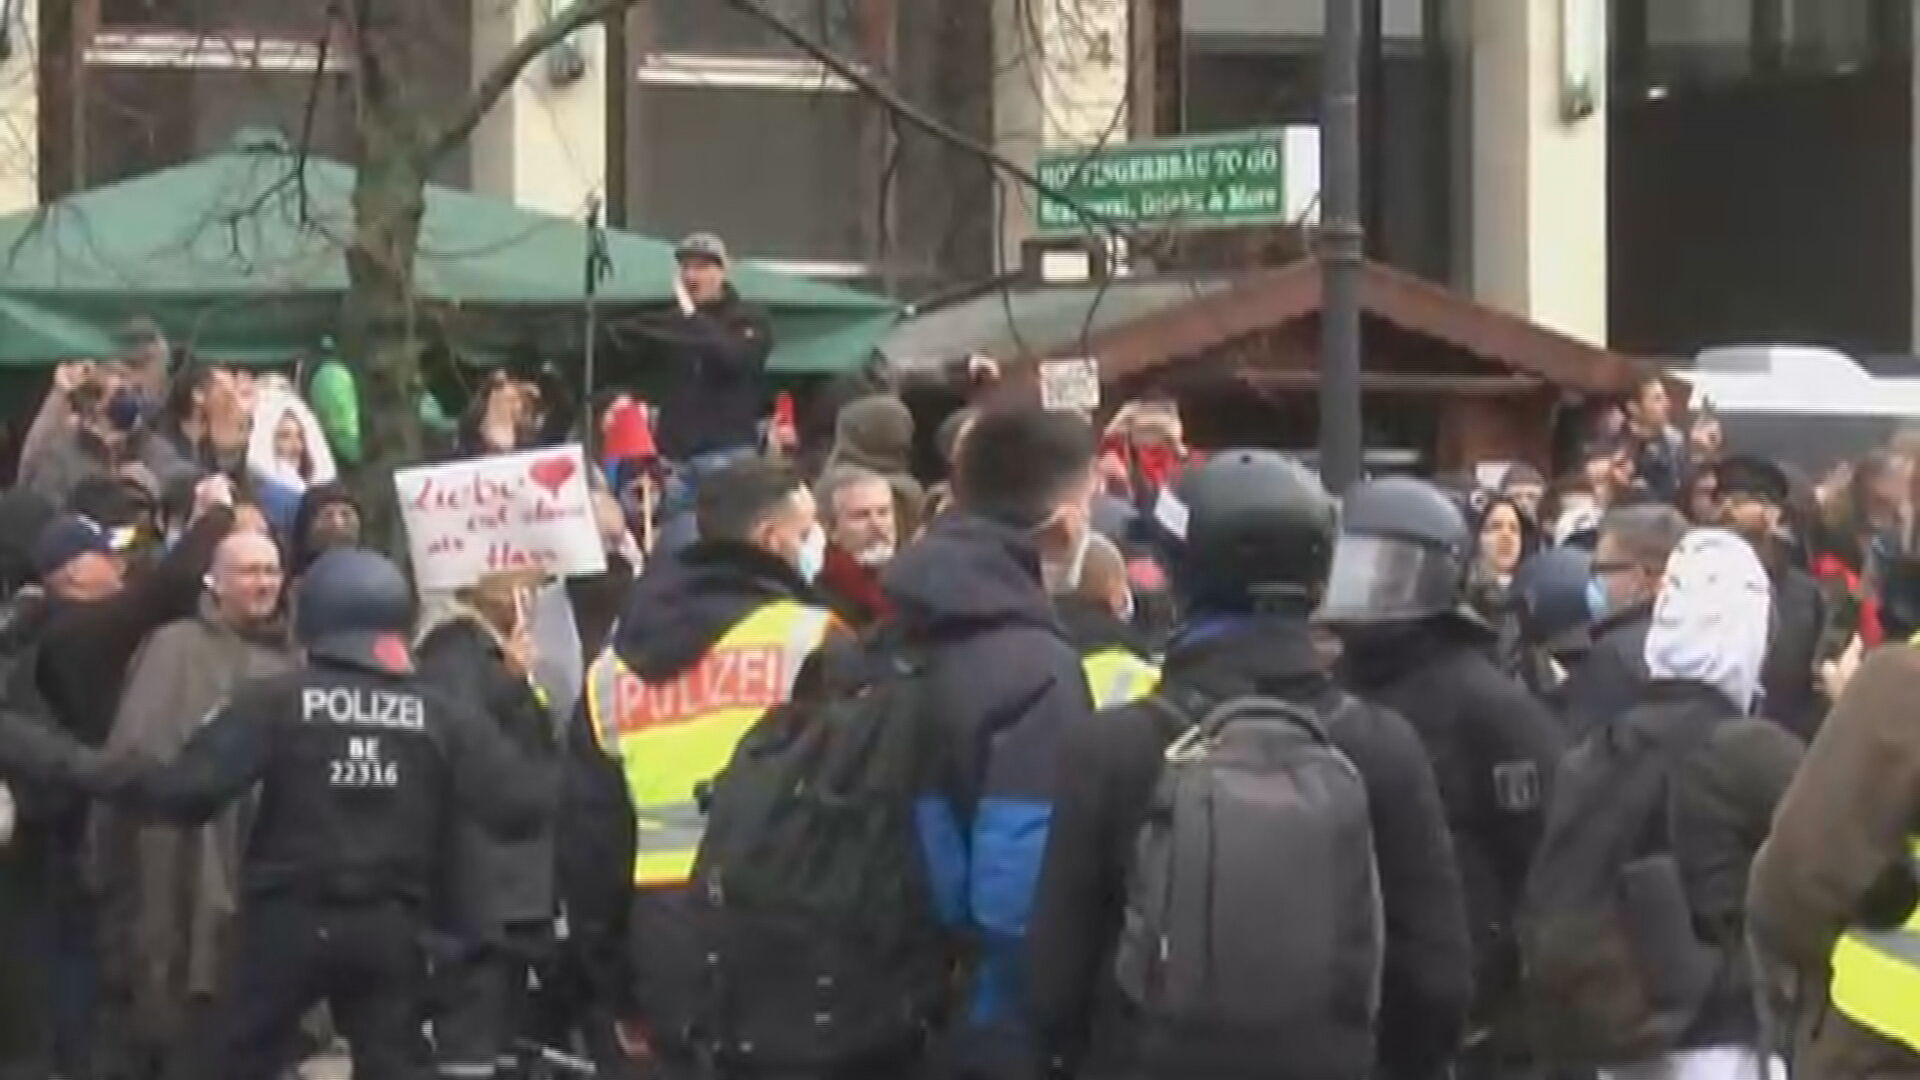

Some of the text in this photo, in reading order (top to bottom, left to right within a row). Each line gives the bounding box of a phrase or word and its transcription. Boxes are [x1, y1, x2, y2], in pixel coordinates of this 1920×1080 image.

[1213, 150, 1243, 176] TO
[1246, 146, 1278, 173] GO
[1229, 183, 1277, 210] More
[619, 649, 777, 724] POLIZEI
[302, 686, 425, 729] POLIZEI
[349, 737, 380, 762] BE
